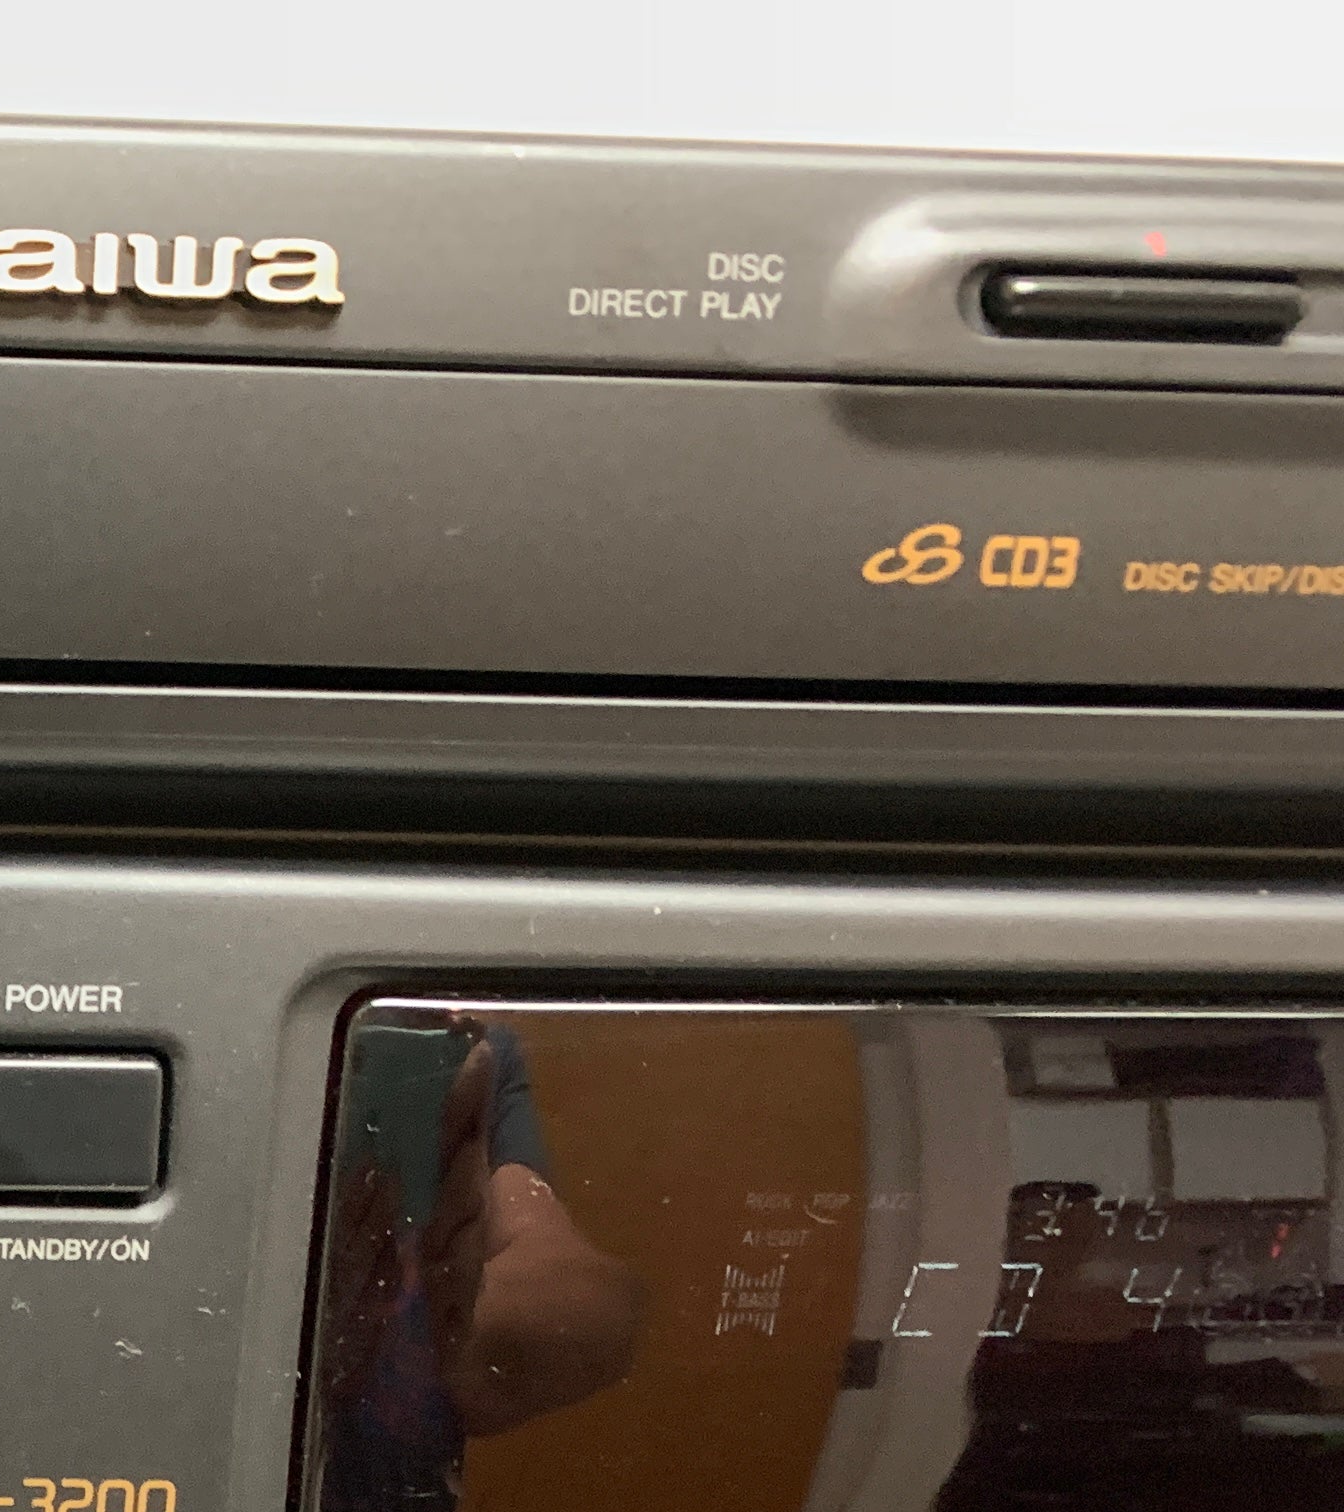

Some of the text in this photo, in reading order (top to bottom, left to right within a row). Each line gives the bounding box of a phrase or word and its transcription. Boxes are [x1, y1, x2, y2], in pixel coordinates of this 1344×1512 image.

[708, 253, 784, 283] DISC
[569, 289, 782, 320] DIRECT PLAY
[980, 535, 1080, 588] CD3
[1124, 562, 1200, 592] DISC
[5, 985, 124, 1012] POWER
